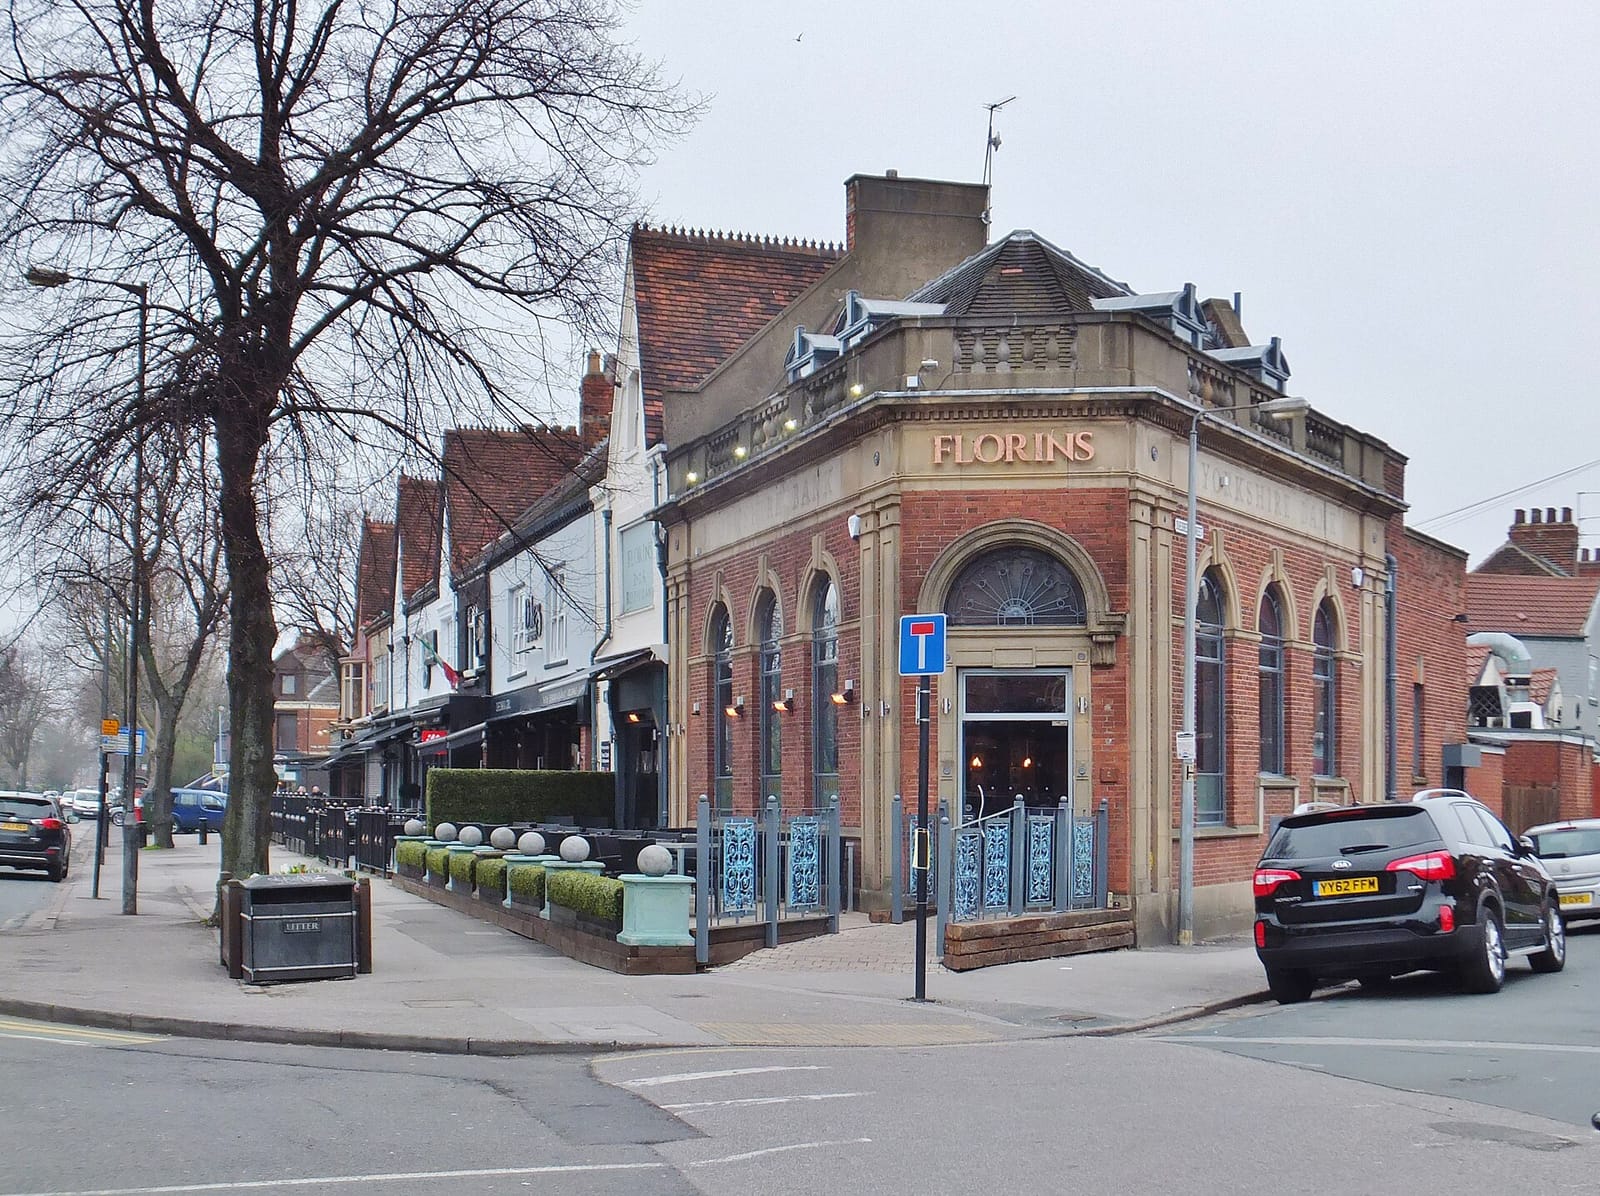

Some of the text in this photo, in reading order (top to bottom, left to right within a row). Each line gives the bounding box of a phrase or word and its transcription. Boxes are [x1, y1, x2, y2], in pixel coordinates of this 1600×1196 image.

[933, 431, 1095, 464] FLORINS
[1320, 879, 1376, 893] YY62 FFM
[286, 922, 319, 931] LITTER
